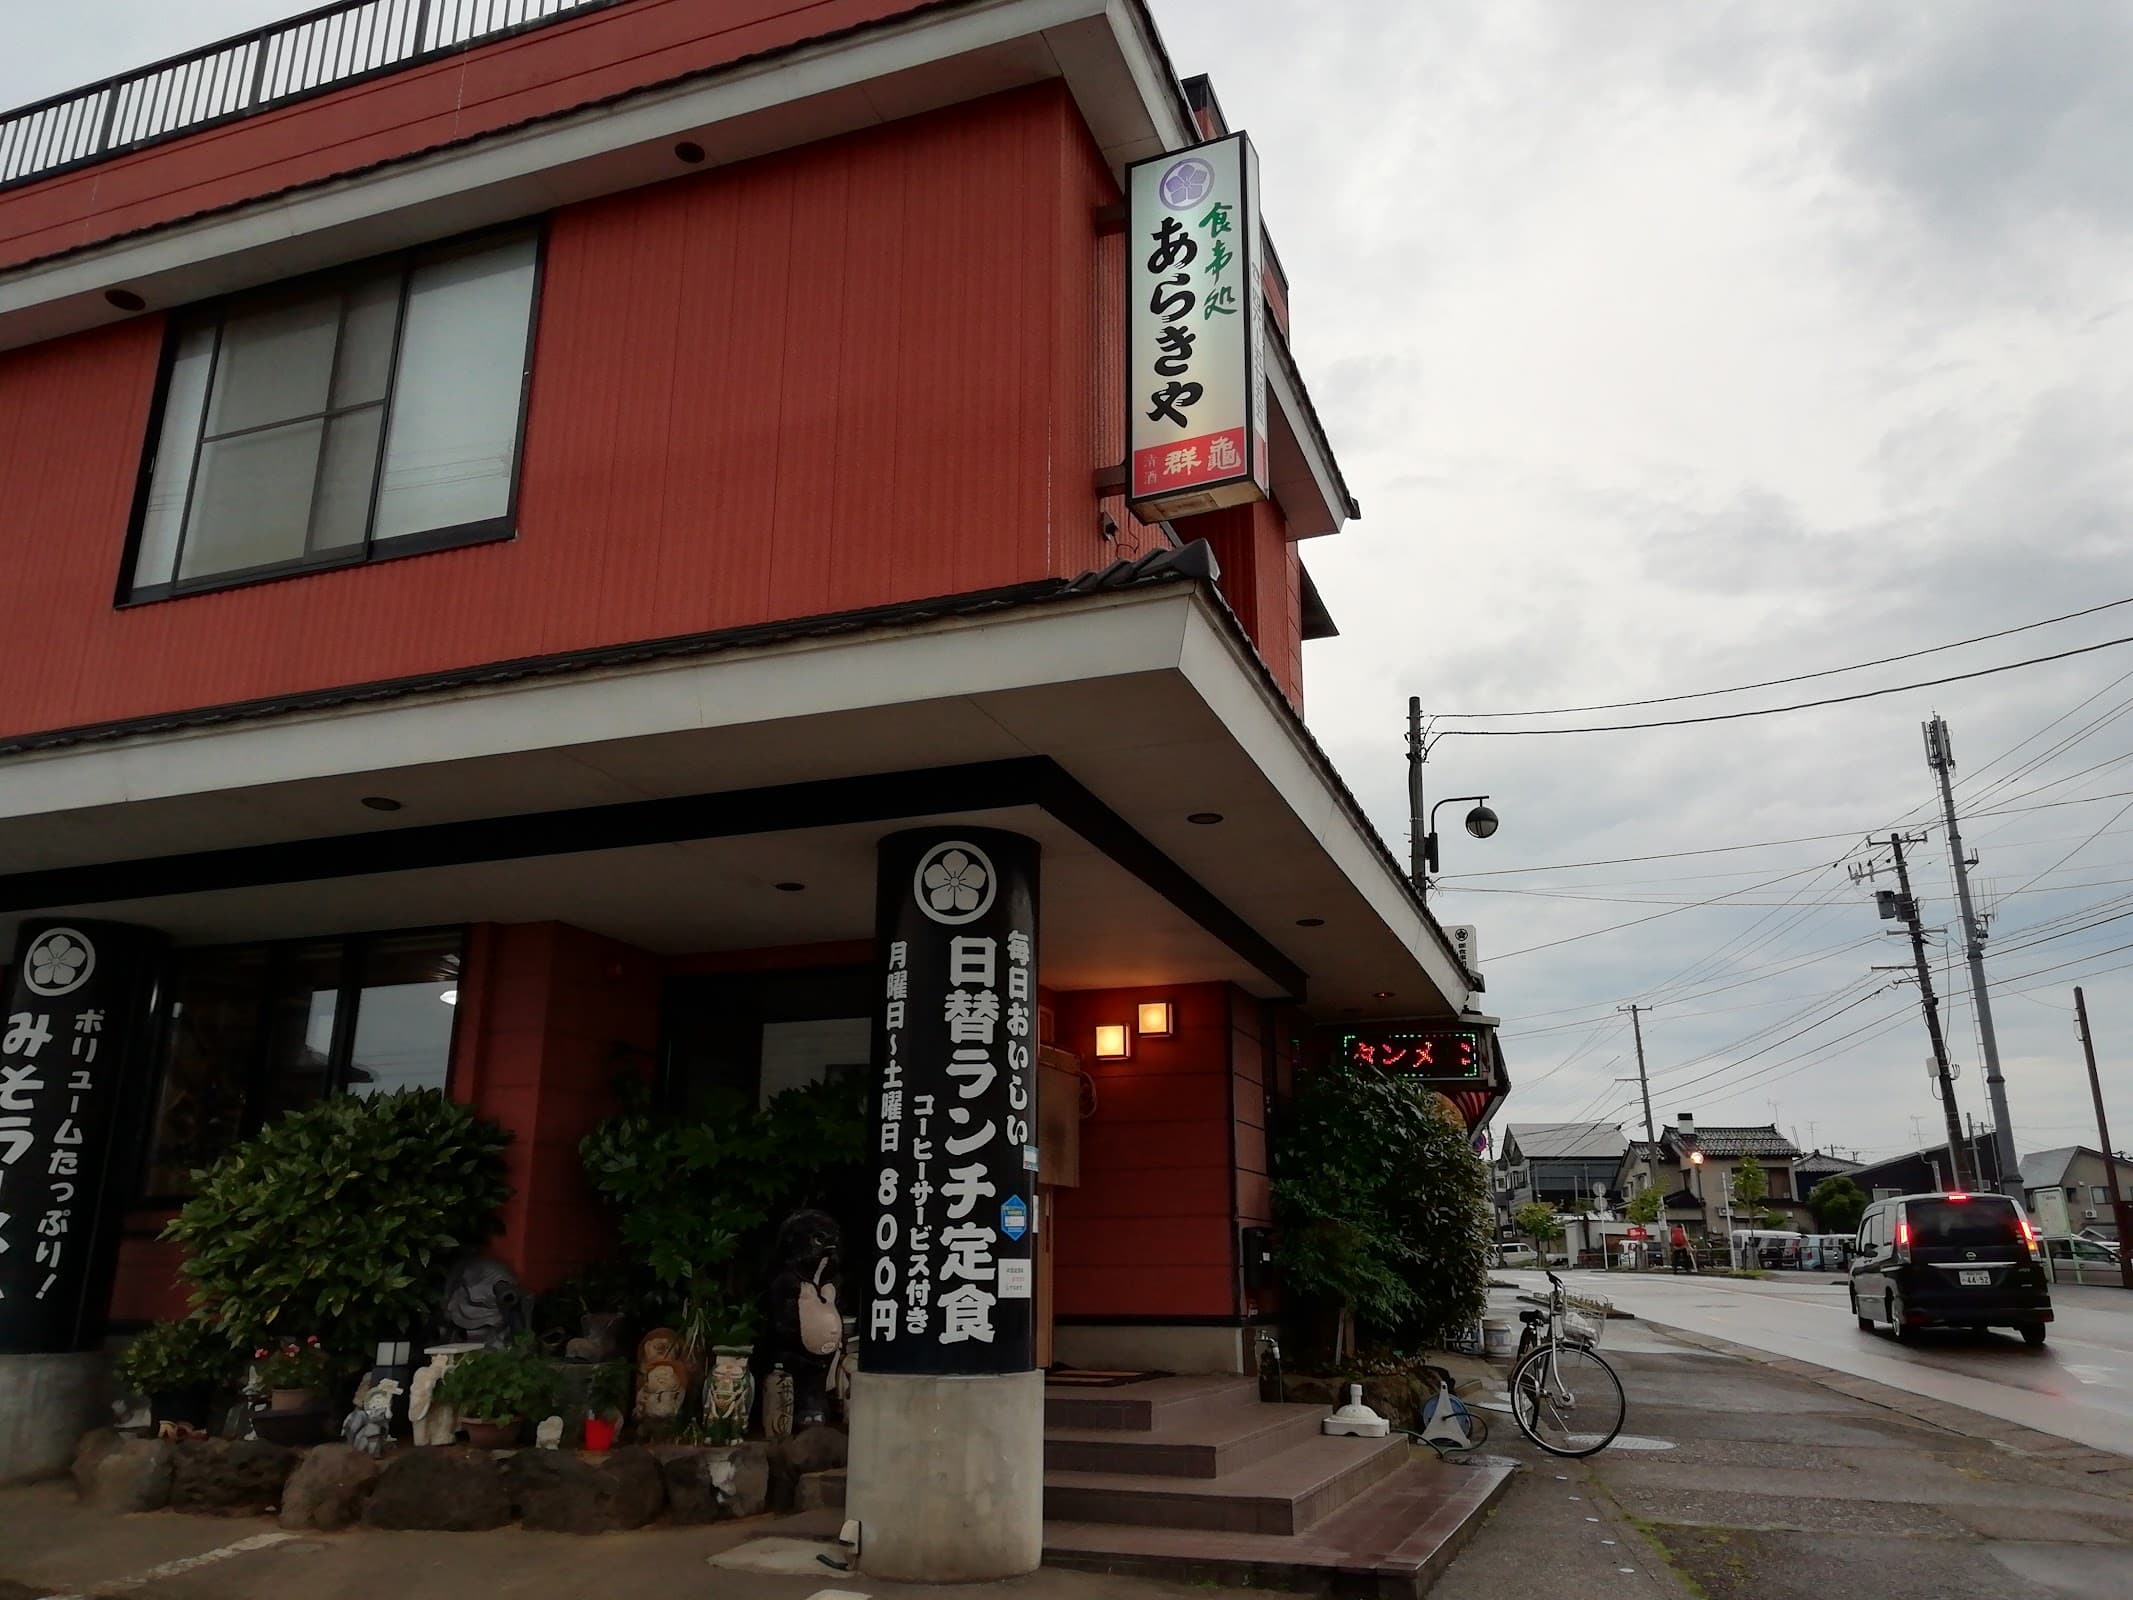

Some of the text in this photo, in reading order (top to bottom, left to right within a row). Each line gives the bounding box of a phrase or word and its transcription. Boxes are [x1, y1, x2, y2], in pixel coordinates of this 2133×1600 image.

[1146, 217, 1204, 429] あらきや
[1199, 202, 1238, 321] 食事処
[938, 935, 998, 1345] 日替ランチ定食
[1006, 930, 1031, 1147] 毎日おいしい
[905, 1094, 935, 1335] コーヒーサービス付き
